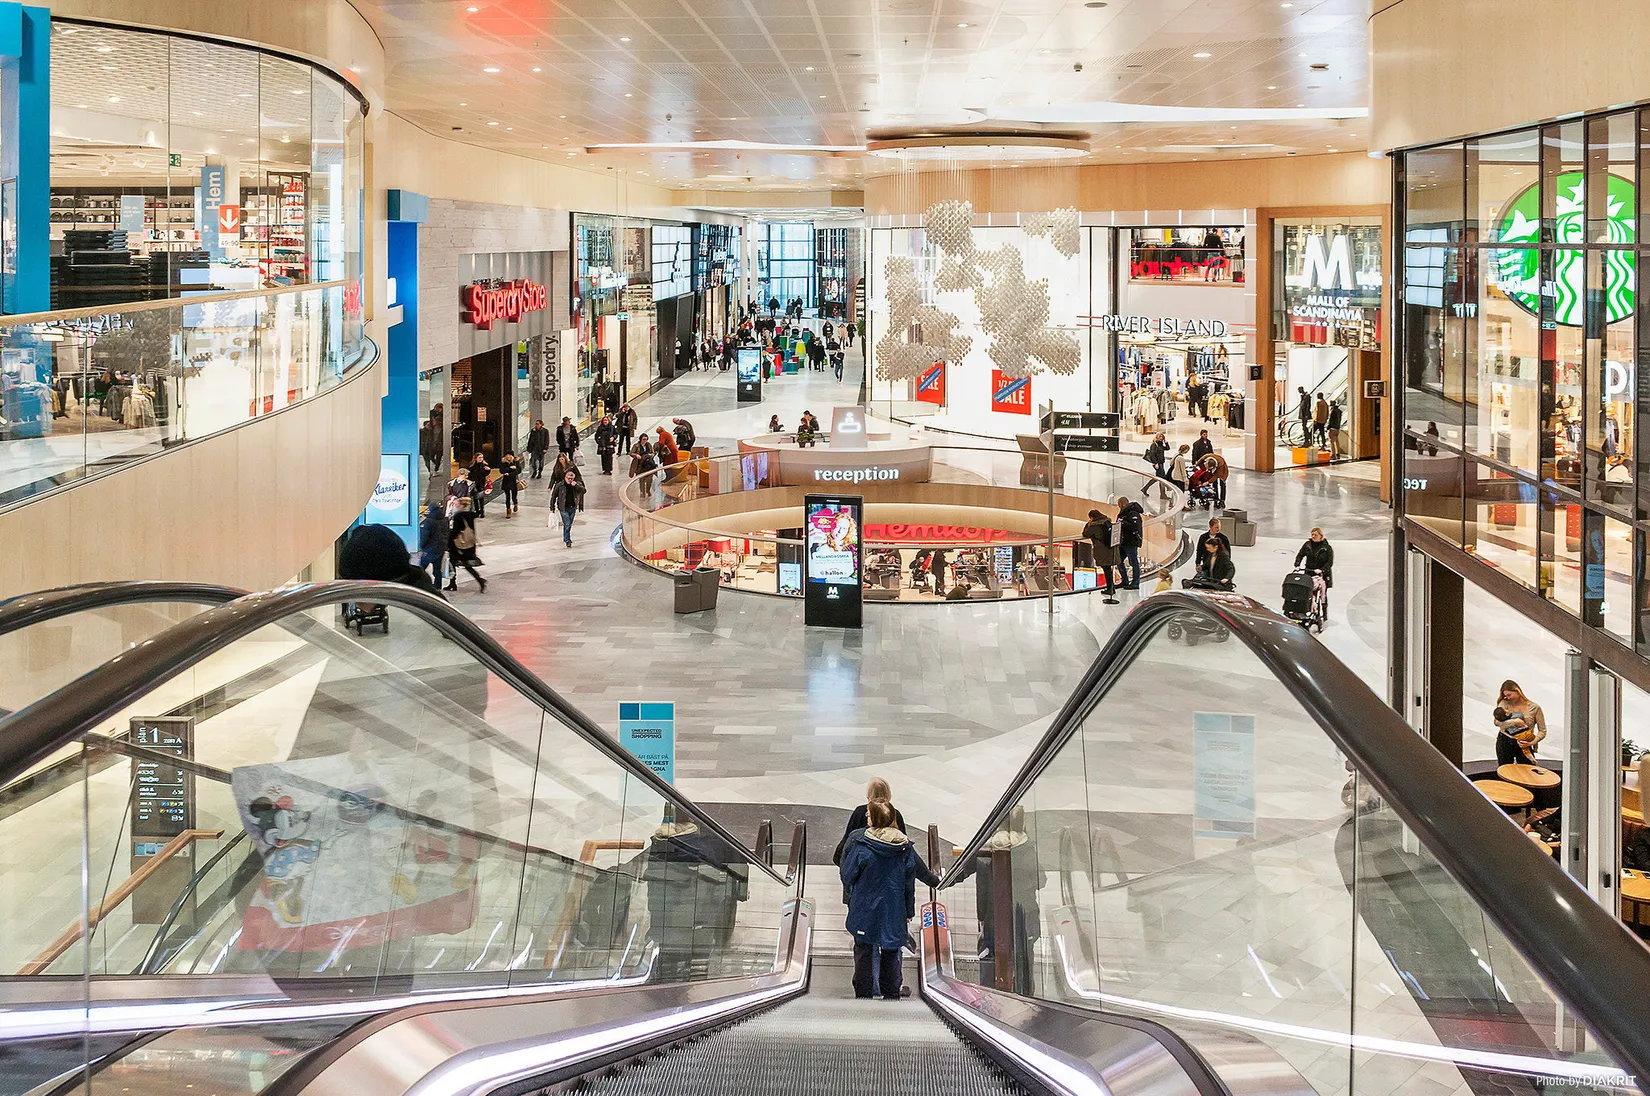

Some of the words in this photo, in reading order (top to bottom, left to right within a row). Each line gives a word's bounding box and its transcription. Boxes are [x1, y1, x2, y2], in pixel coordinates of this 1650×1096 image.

[206, 171, 221, 210] Hem
[1302, 234, 1355, 290] M
[1306, 294, 1335, 306] MALL
[1335, 296, 1350, 308] OF
[1292, 305, 1364, 320] SCANDINAVIA
[1102, 315, 1150, 333] RIVER
[1158, 317, 1227, 337] ISLAND
[813, 466, 899, 484] reception
[137, 727, 148, 743] plan
[149, 727, 158, 743] 1
